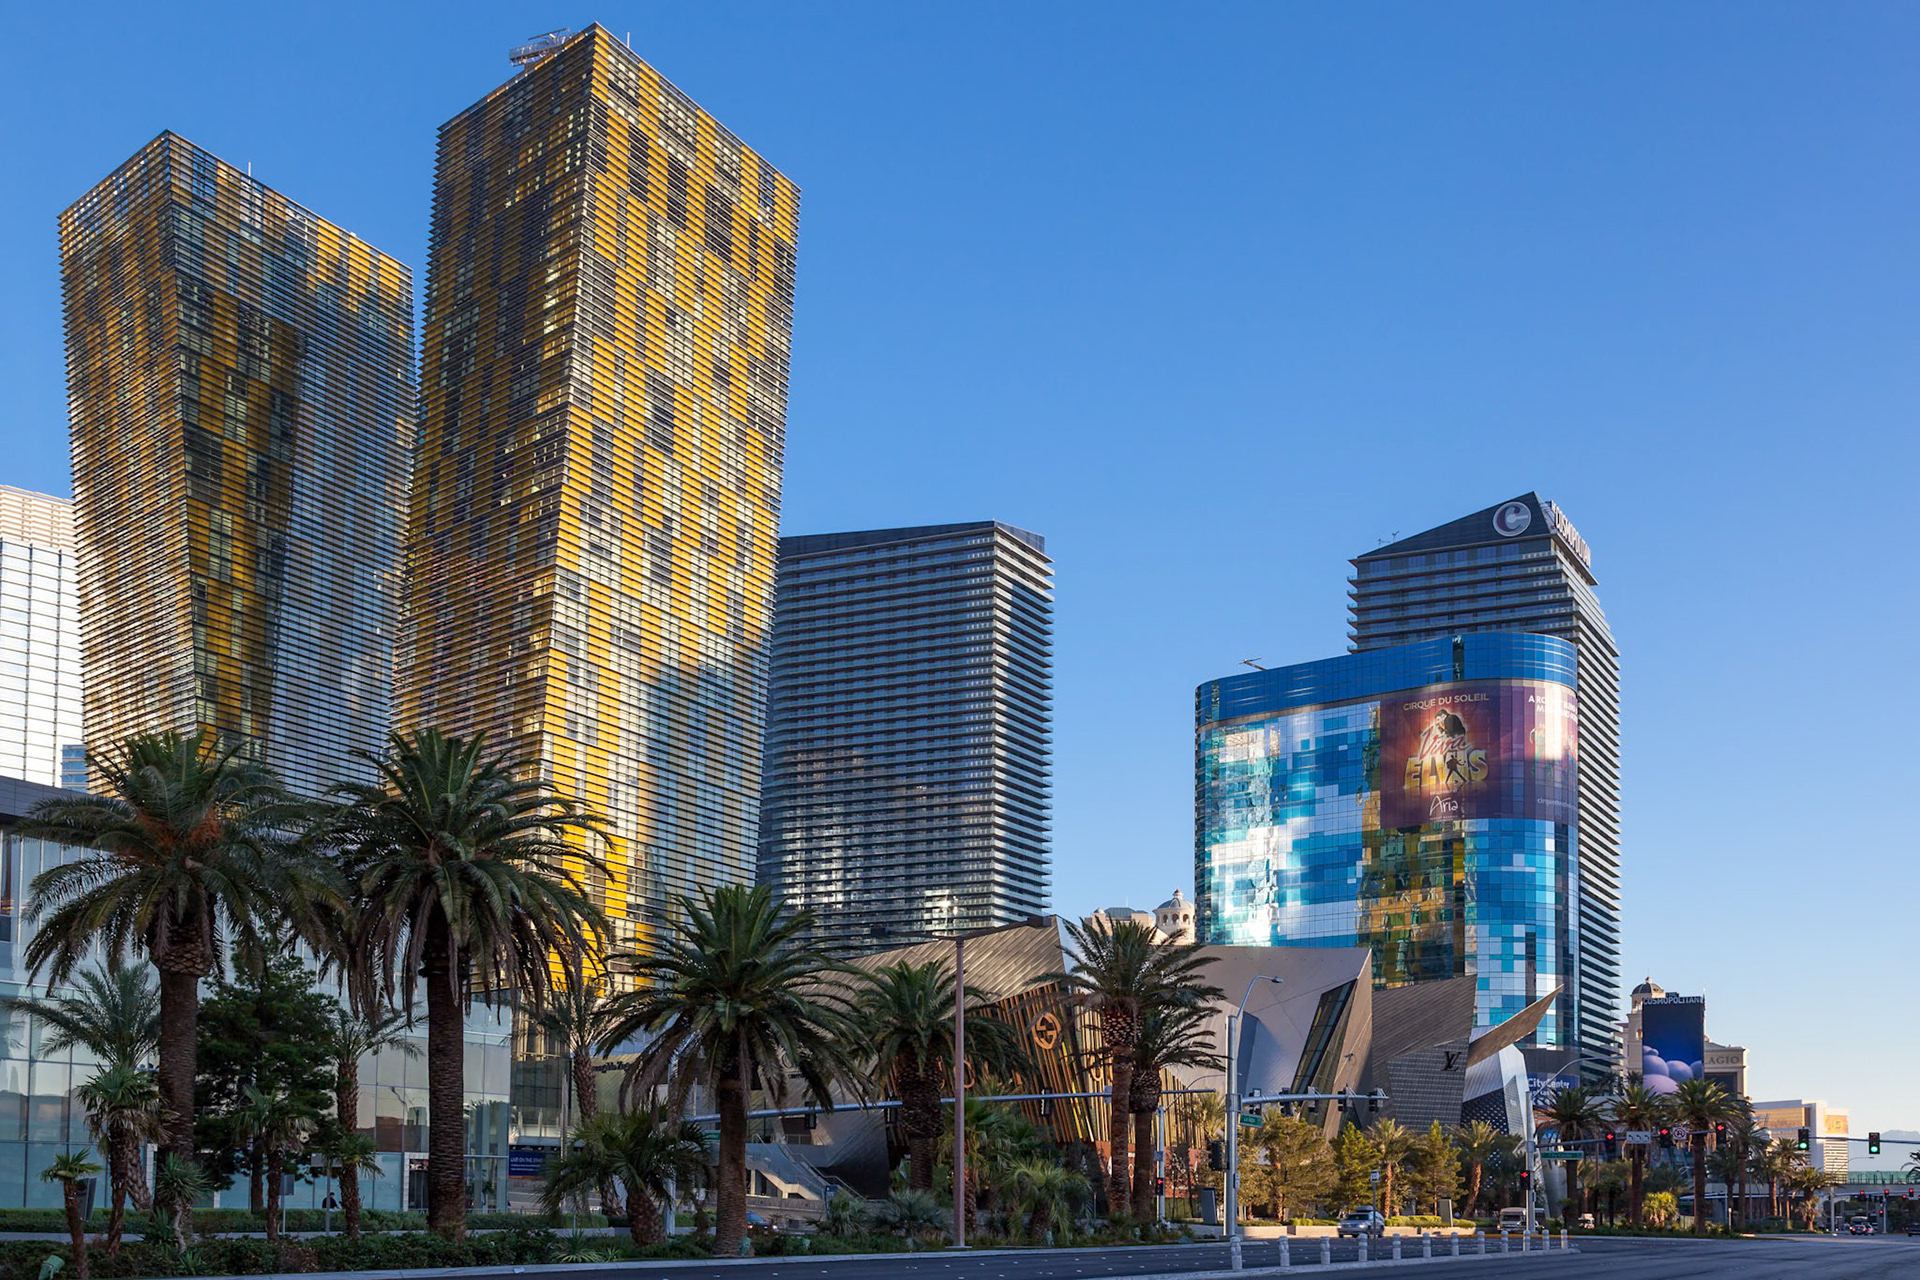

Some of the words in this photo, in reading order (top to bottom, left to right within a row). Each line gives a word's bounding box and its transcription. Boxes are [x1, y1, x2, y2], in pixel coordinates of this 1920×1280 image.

[1403, 698, 1436, 711] CIRQUE
[1438, 696, 1452, 705] DU
[1454, 693, 1490, 702] SOLEIL
[1420, 725, 1471, 759] Viva
[1429, 795, 1459, 816] Aria
[1643, 996, 1700, 1005] COSMOPOLITAN
